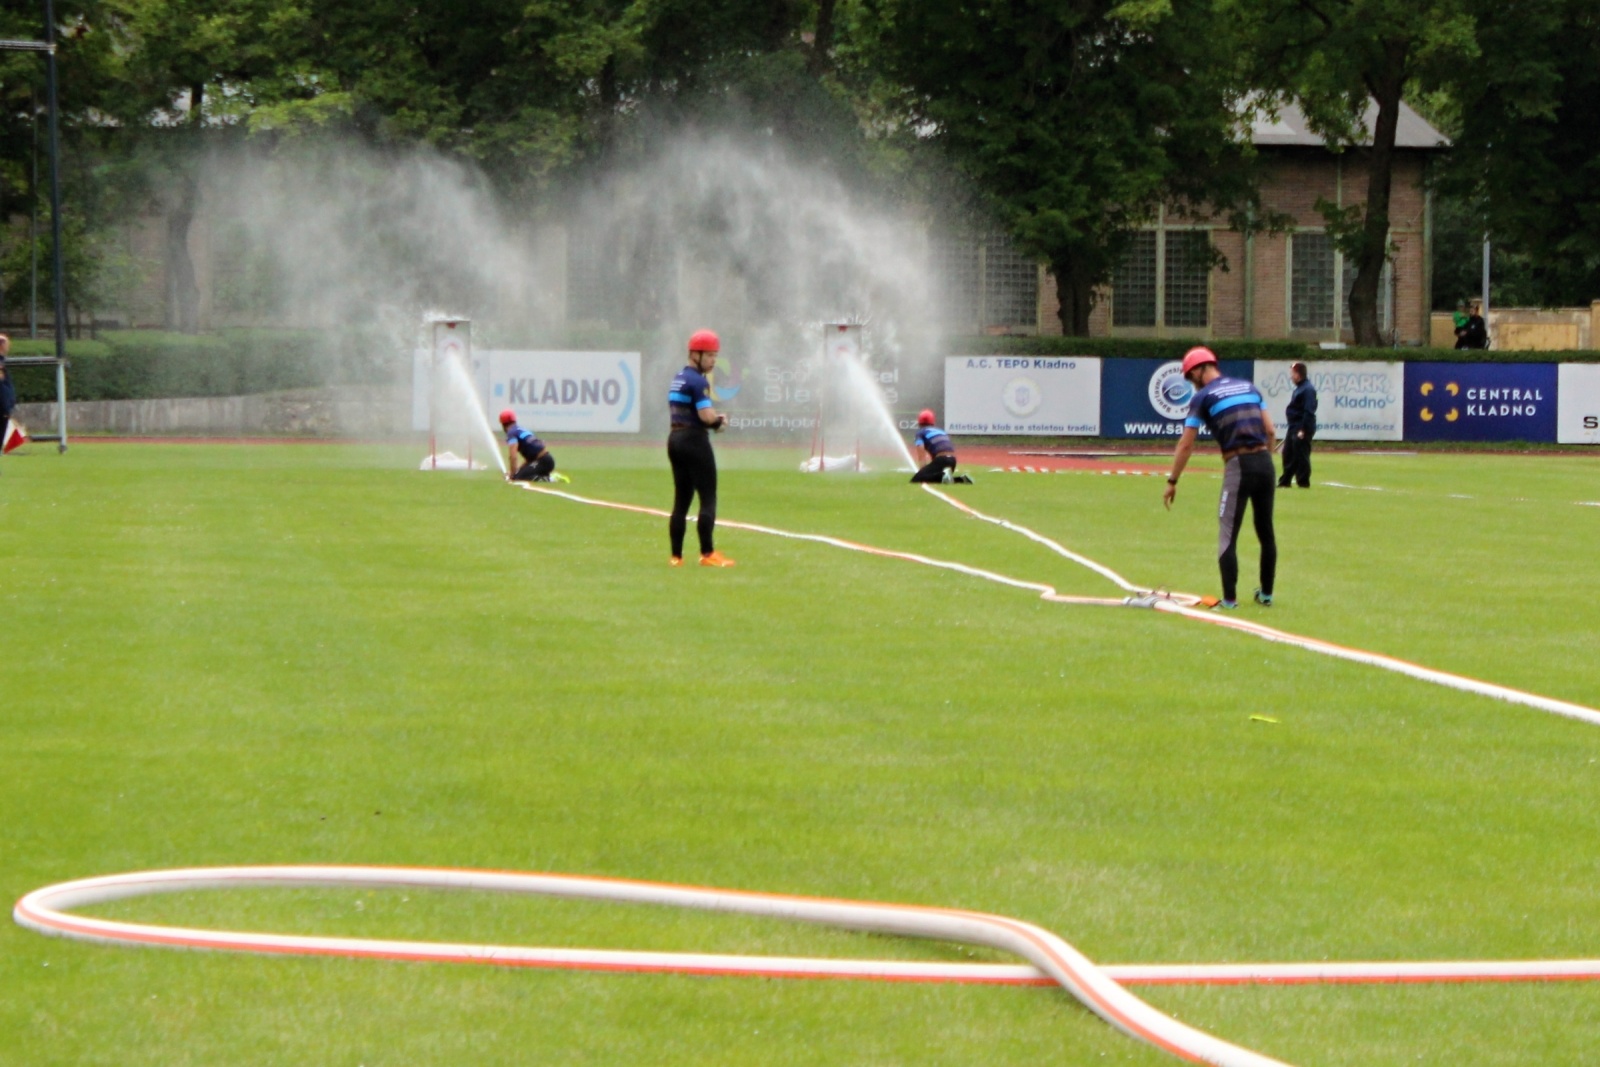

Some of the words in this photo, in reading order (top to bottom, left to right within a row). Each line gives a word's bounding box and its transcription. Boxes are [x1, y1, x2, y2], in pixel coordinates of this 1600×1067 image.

[966, 359, 992, 369] A.C.
[996, 359, 1030, 369] TEPO
[1033, 359, 1076, 370] Kladno
[1274, 371, 1387, 393] AUAPARK
[508, 378, 621, 405] KLADNO
[1466, 388, 1543, 401] CENTRAL
[1335, 395, 1386, 409] Kladno
[1466, 404, 1537, 416] KLADNO
[949, 423, 988, 433] Atletický
[992, 423, 1011, 431] klub
[1027, 424, 1064, 432] stoletou
